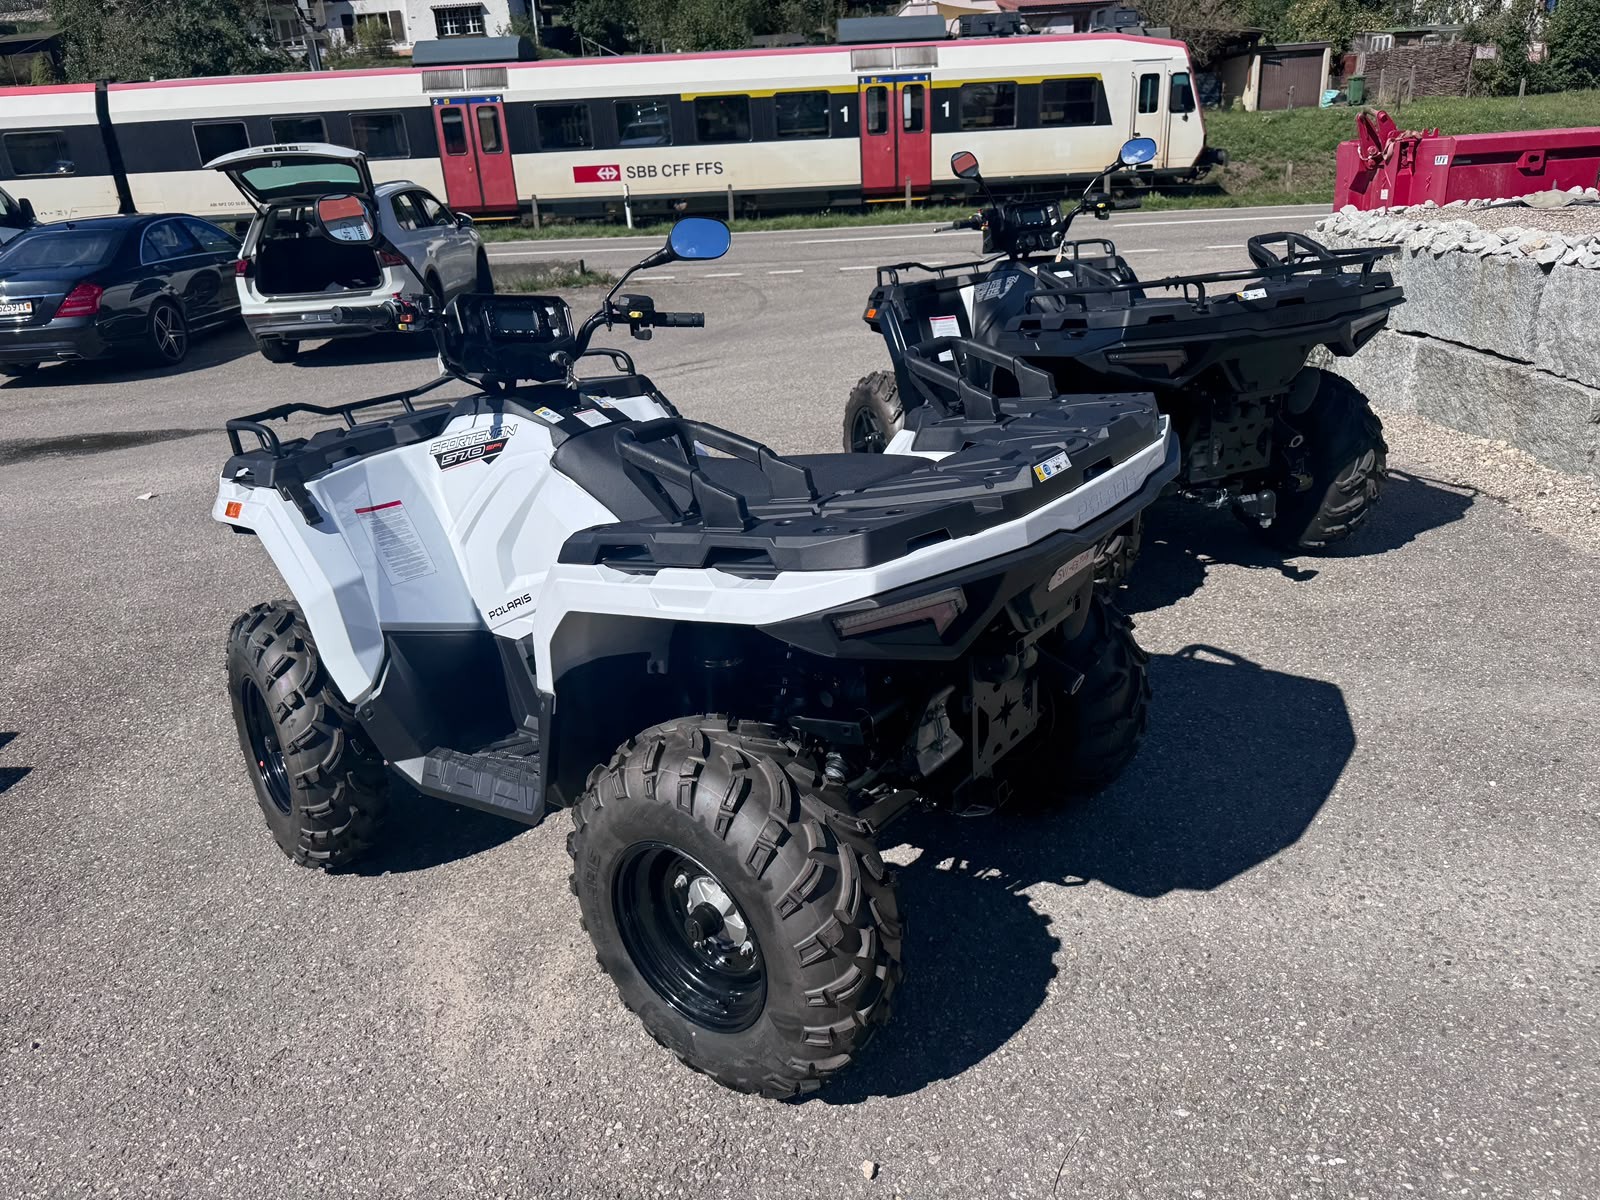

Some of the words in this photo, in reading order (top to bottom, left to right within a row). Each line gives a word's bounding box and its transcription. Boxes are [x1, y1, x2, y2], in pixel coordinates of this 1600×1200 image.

[840, 105, 849, 123] 1
[941, 101, 950, 118] 1
[626, 165, 658, 179] SBB
[661, 163, 691, 178] CFF
[695, 161, 724, 176] FFS
[429, 424, 518, 455] SPORTSMAN
[441, 444, 486, 466] 570
[488, 593, 532, 620] POLARIS
